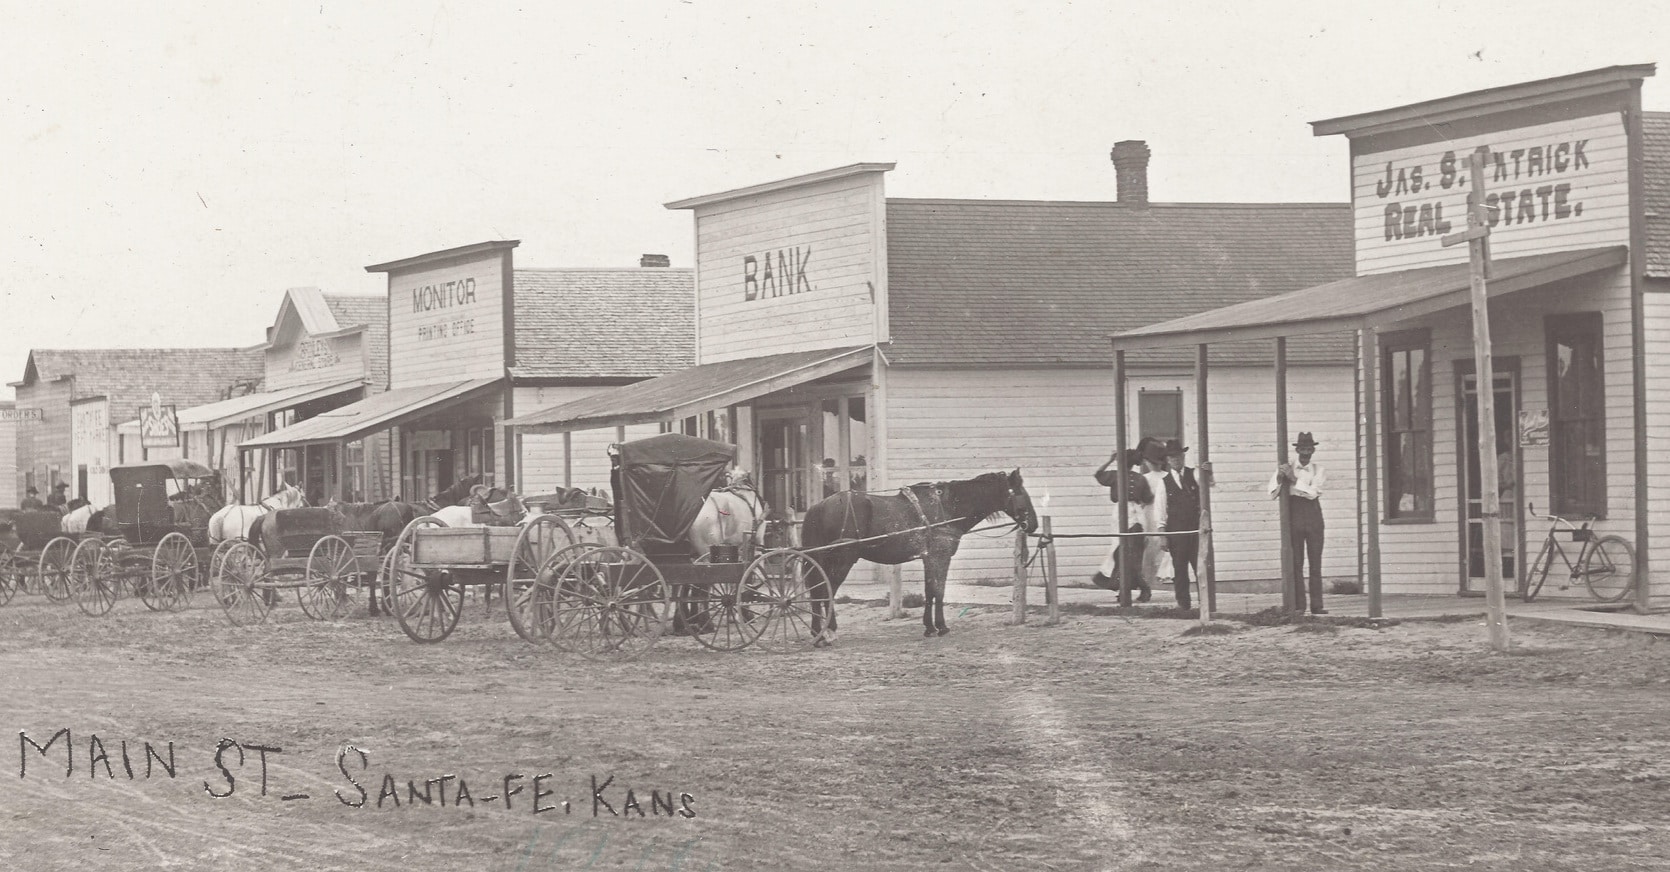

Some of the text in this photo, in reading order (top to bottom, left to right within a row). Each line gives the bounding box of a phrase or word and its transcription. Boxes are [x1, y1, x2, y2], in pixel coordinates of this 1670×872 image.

[1376, 160, 1430, 198] JAS.
[1384, 201, 1452, 242] REAL
[744, 245, 818, 301] BANK.
[412, 277, 476, 313] MONITOR
[452, 318, 475, 337] OFFICE
